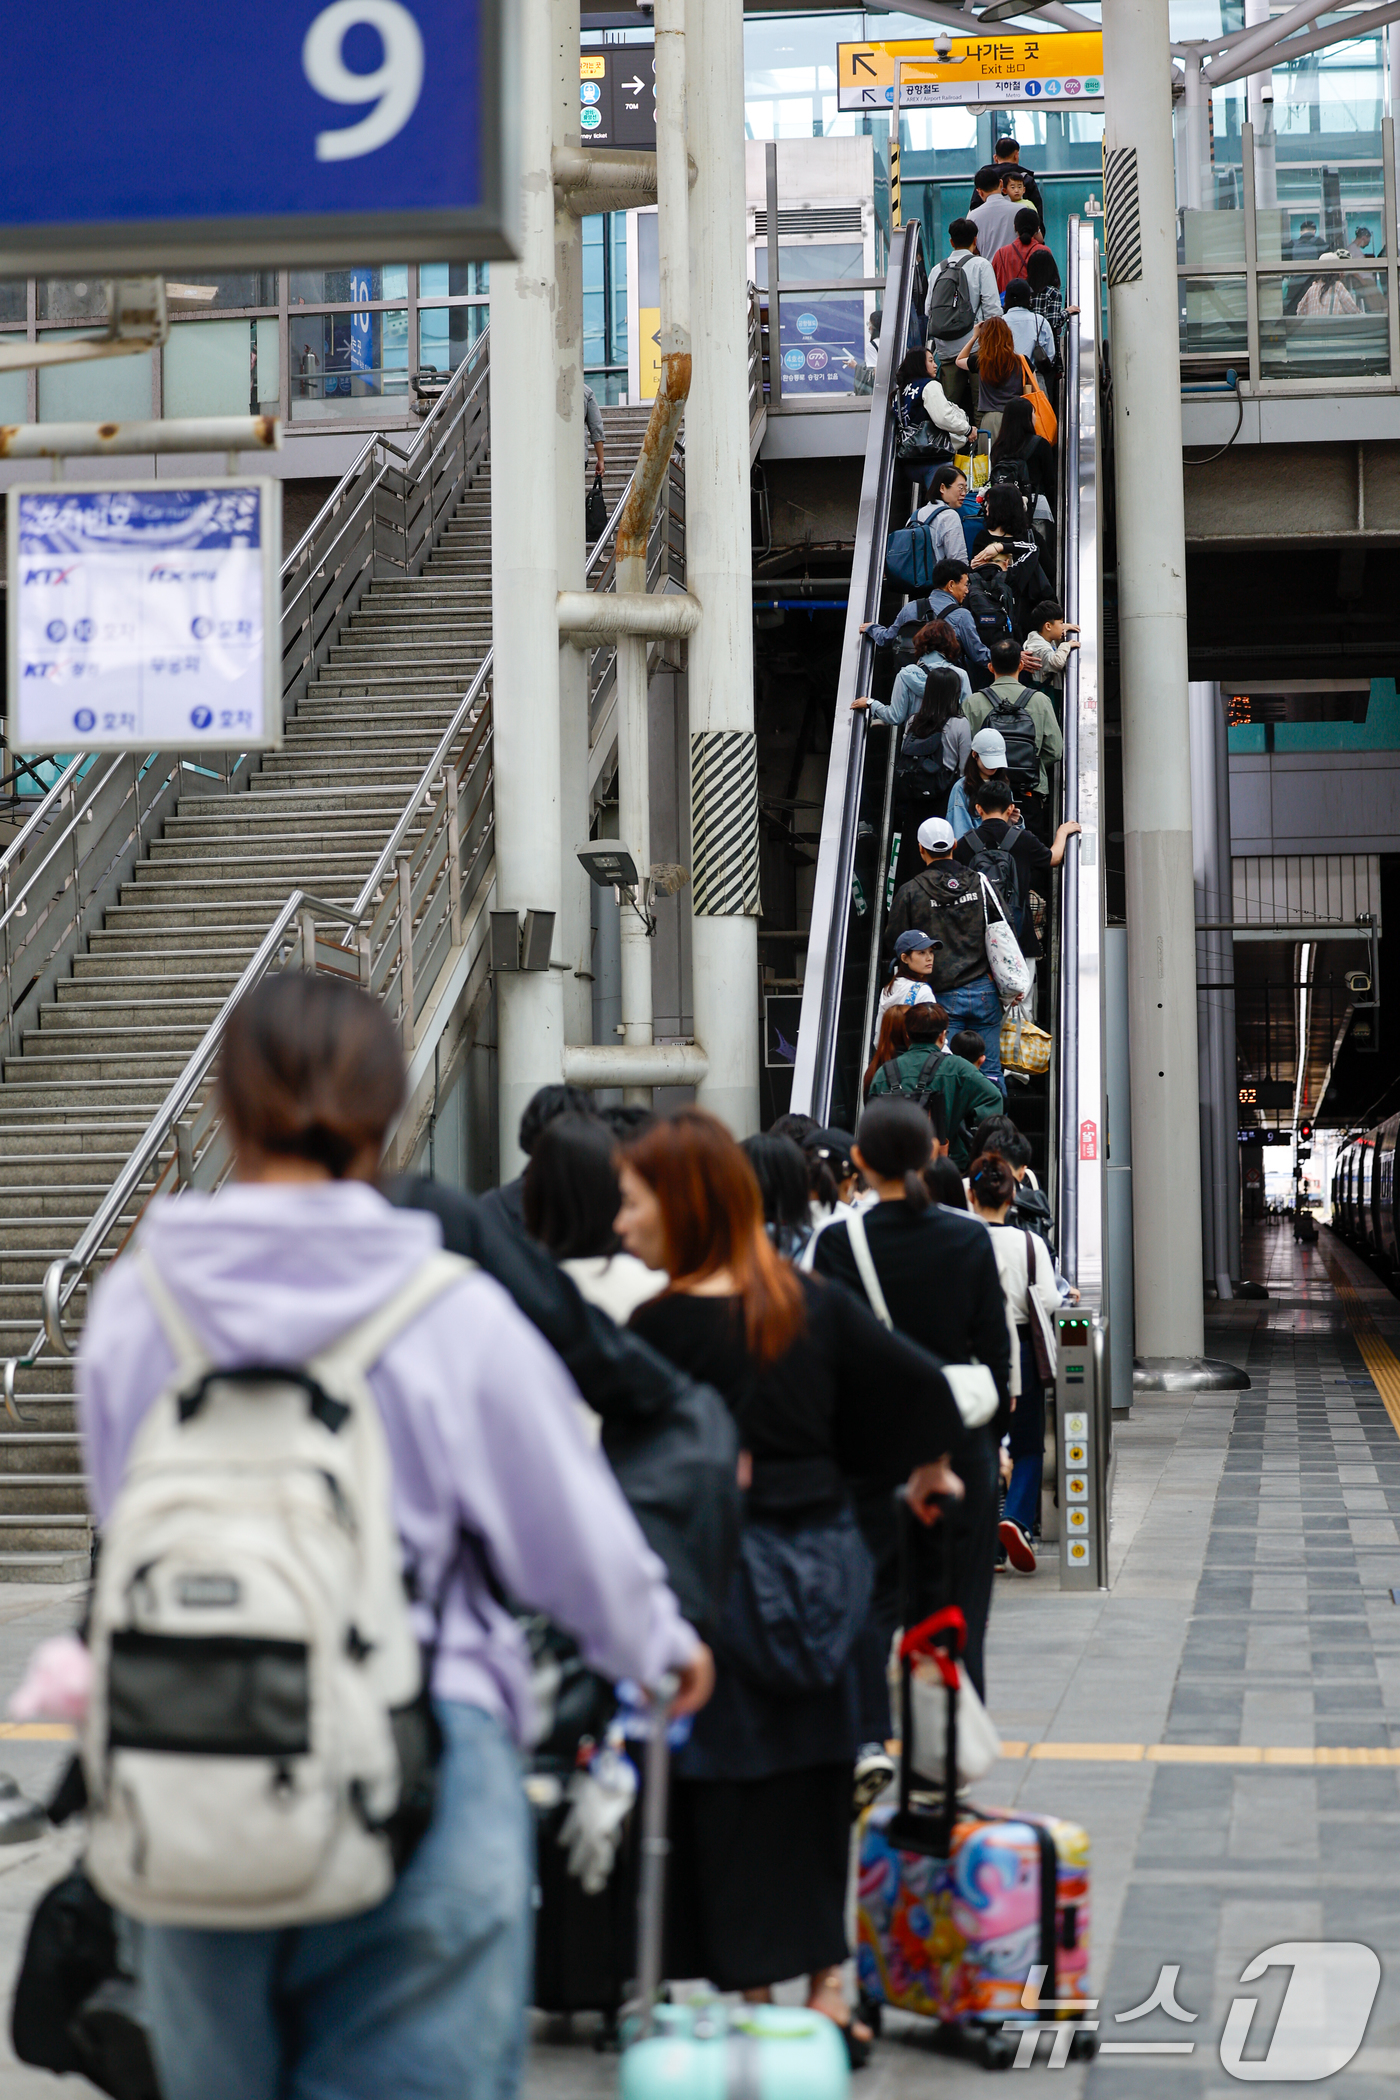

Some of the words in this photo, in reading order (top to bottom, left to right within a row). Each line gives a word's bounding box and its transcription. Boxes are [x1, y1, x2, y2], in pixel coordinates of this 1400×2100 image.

[966, 43, 1014, 62] 나가는
[1024, 41, 1039, 60] 곳
[981, 63, 1002, 75] Exit
[1006, 63, 1026, 73] 出口
[303, 0, 425, 163] 9
[995, 81, 1021, 92] 지하철
[906, 84, 940, 96] 공항철도
[786, 355, 803, 363] 4호선
[808, 373, 825, 381] 승강기
[826, 373, 839, 381] 없음
[24, 563, 80, 586] KTX
[102, 711, 135, 732] 호차
[219, 709, 252, 731] 호차
[1238, 1088, 1257, 1104] 02
[1267, 1132, 1274, 1142] 9
